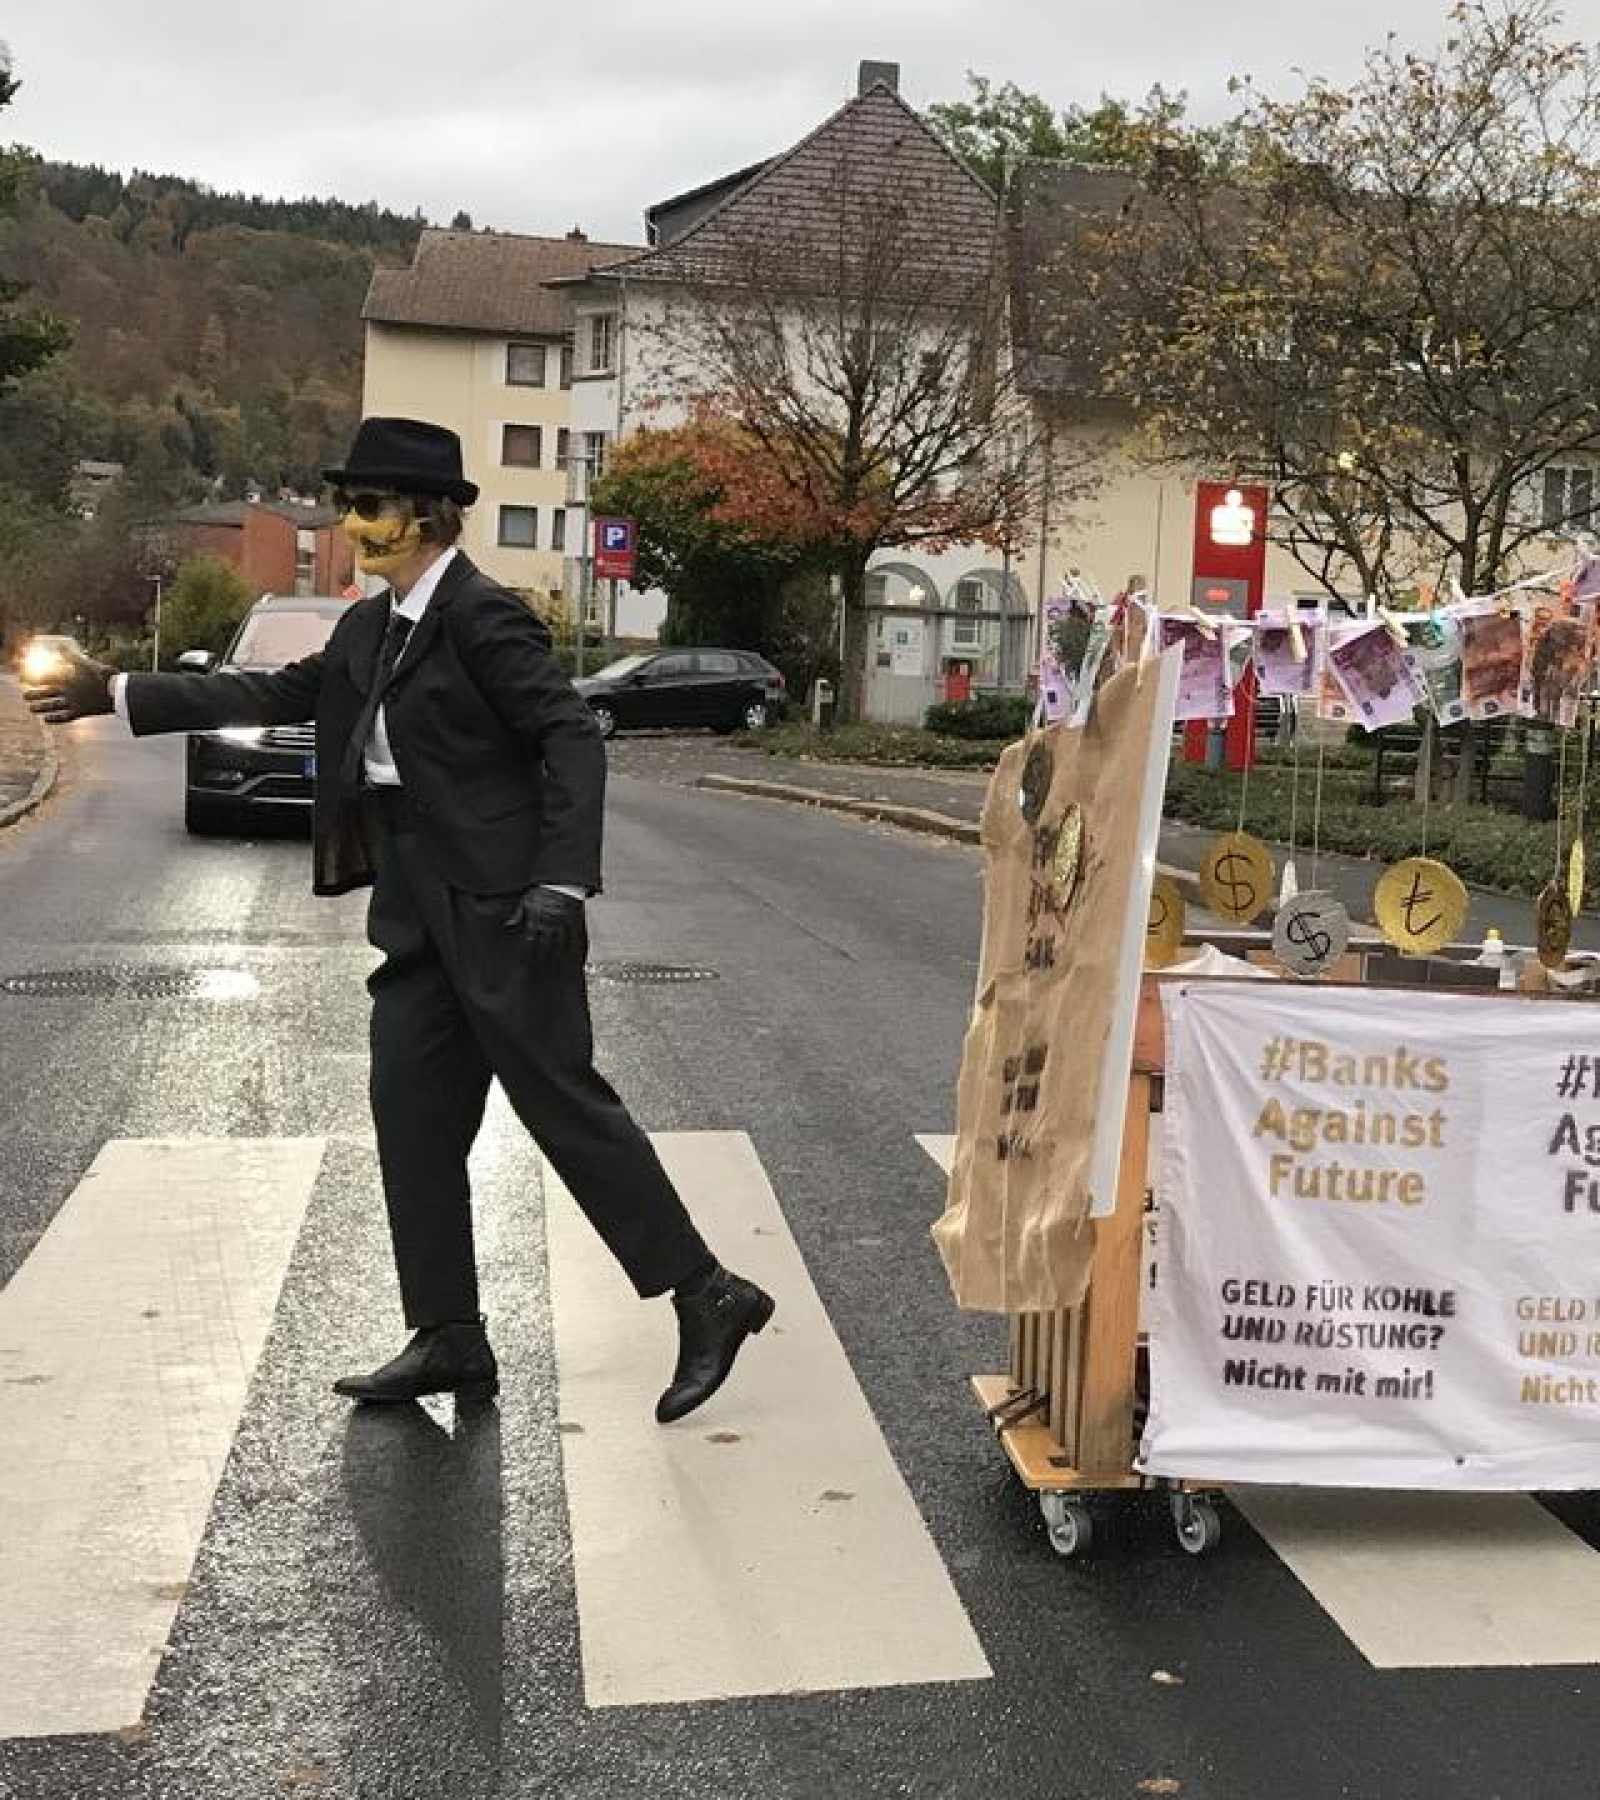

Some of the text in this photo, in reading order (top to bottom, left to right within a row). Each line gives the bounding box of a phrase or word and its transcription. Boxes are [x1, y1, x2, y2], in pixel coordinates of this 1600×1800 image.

[606, 526, 625, 546] P
[1259, 1036, 1449, 1091] #Banks
[1253, 1097, 1448, 1153] Against
[1269, 1153, 1425, 1206] Future
[1222, 1279, 1457, 1318] GELD FÜR KOHLE
[1517, 1296, 1586, 1322] GELD
[1222, 1314, 1446, 1350] UND RÜSTUNG?
[1519, 1328, 1578, 1359] UND
[1224, 1359, 1434, 1400] Nicht mit mir!
[1520, 1374, 1598, 1404] Nicht
